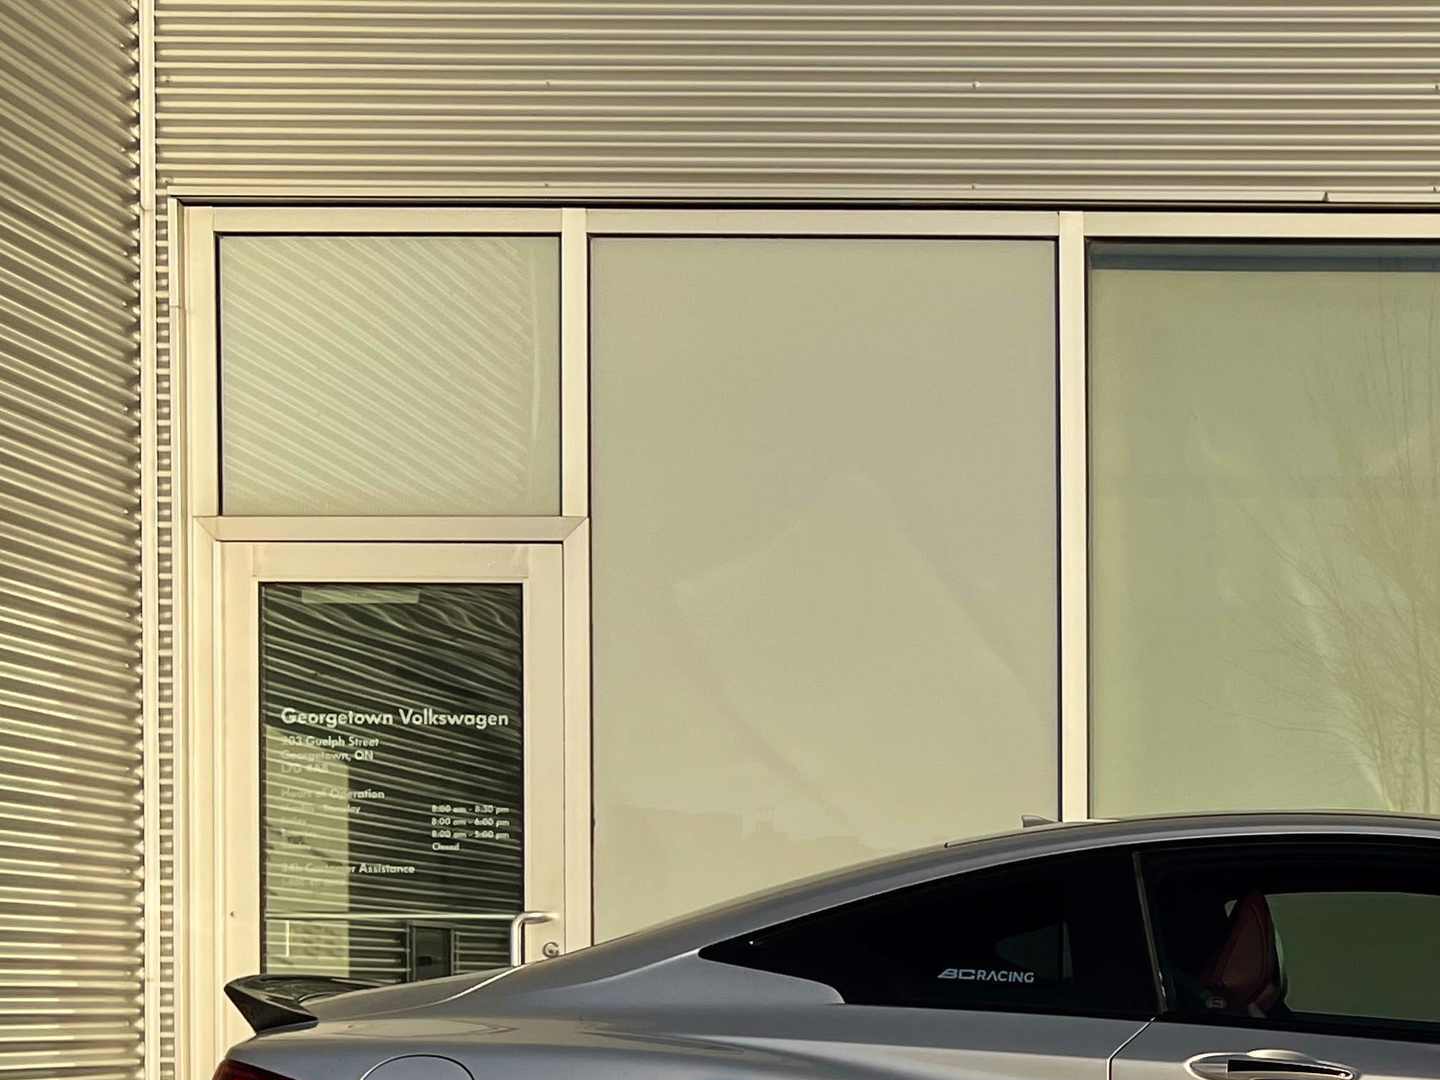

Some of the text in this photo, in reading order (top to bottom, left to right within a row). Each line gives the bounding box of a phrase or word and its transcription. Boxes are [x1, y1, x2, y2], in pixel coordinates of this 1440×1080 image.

[280, 707, 509, 730] Georgetown Volkswagen
[305, 735, 346, 749] Guelph
[348, 736, 380, 747] Street
[354, 750, 374, 761] ON
[358, 862, 416, 874] Assistance
